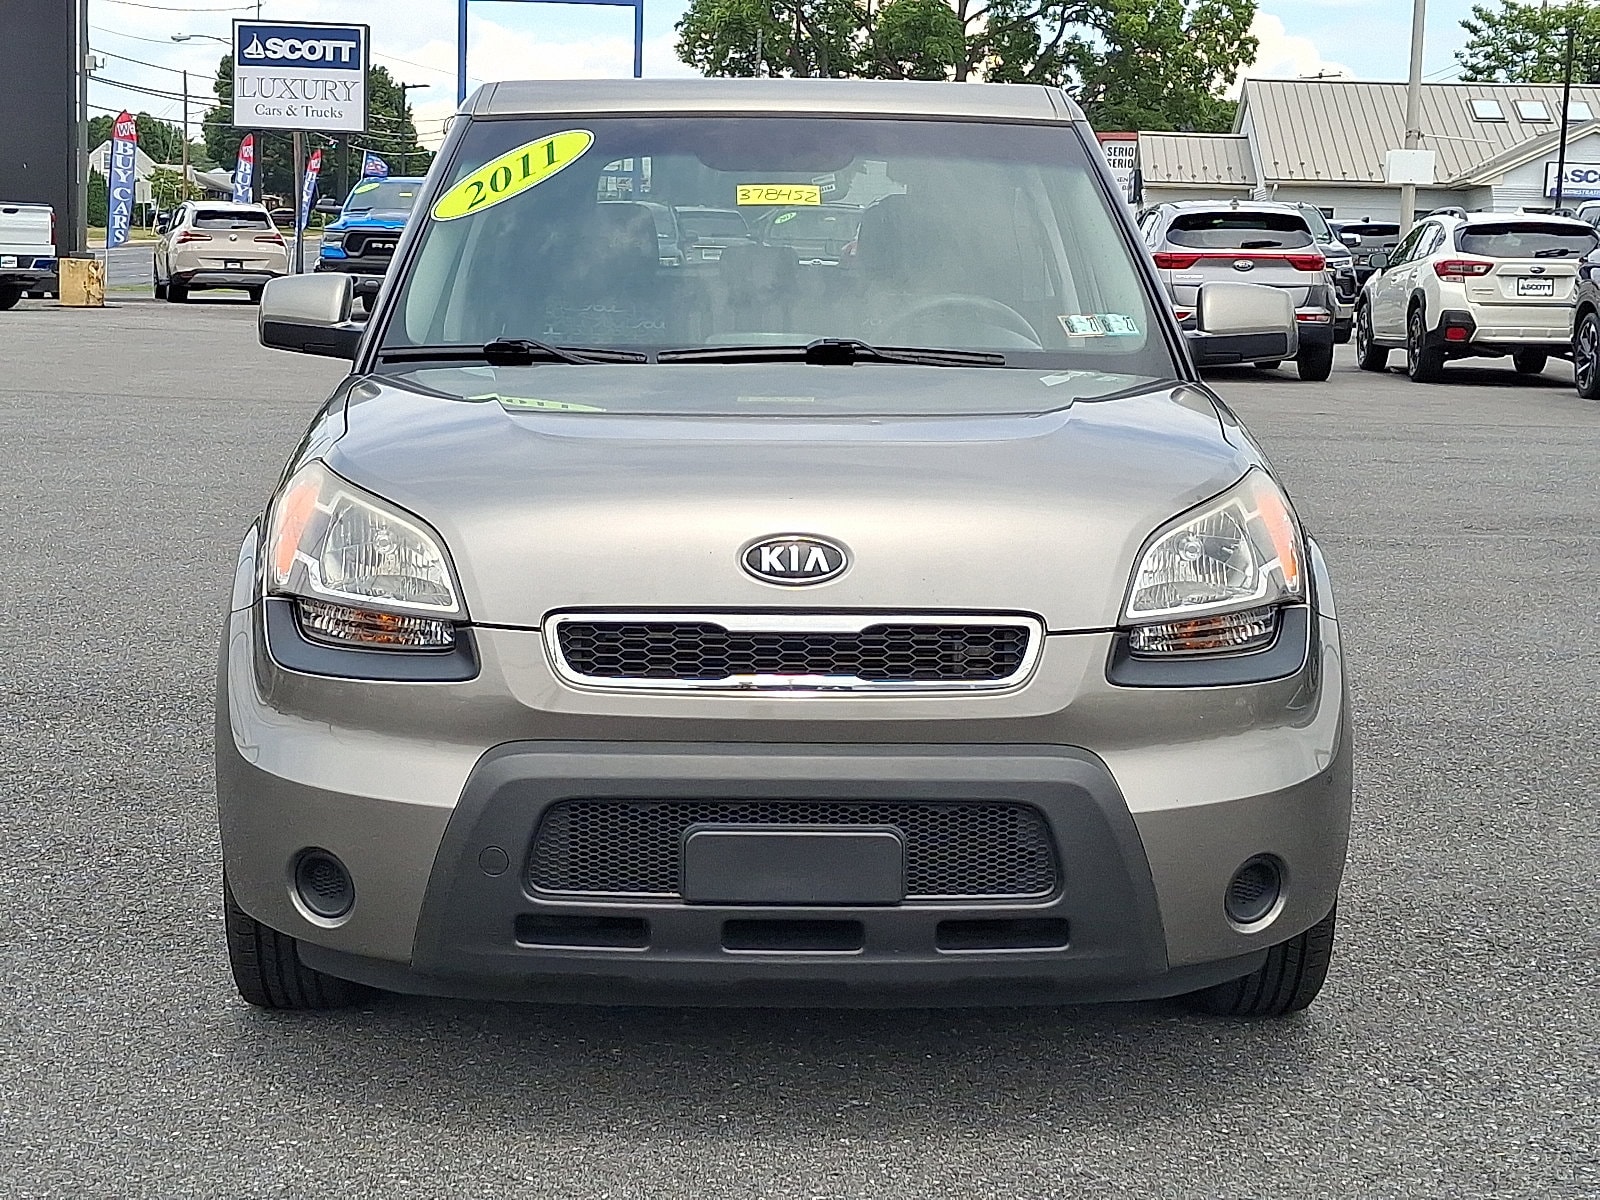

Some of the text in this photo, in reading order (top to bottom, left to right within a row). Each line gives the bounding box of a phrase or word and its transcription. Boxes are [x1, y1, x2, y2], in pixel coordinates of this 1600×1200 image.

[264, 37, 356, 62] SCOTT
[238, 76, 360, 101] LUXURY
[254, 103, 343, 119] Cars & Trucks
[1107, 146, 1135, 157] SERIO
[1107, 158, 1134, 169] SERIO
[464, 140, 561, 210] 2011
[1570, 169, 1600, 183] SC
[113, 141, 134, 242] BUY CARS
[739, 188, 818, 203] 378452
[760, 545, 830, 572] KIA
